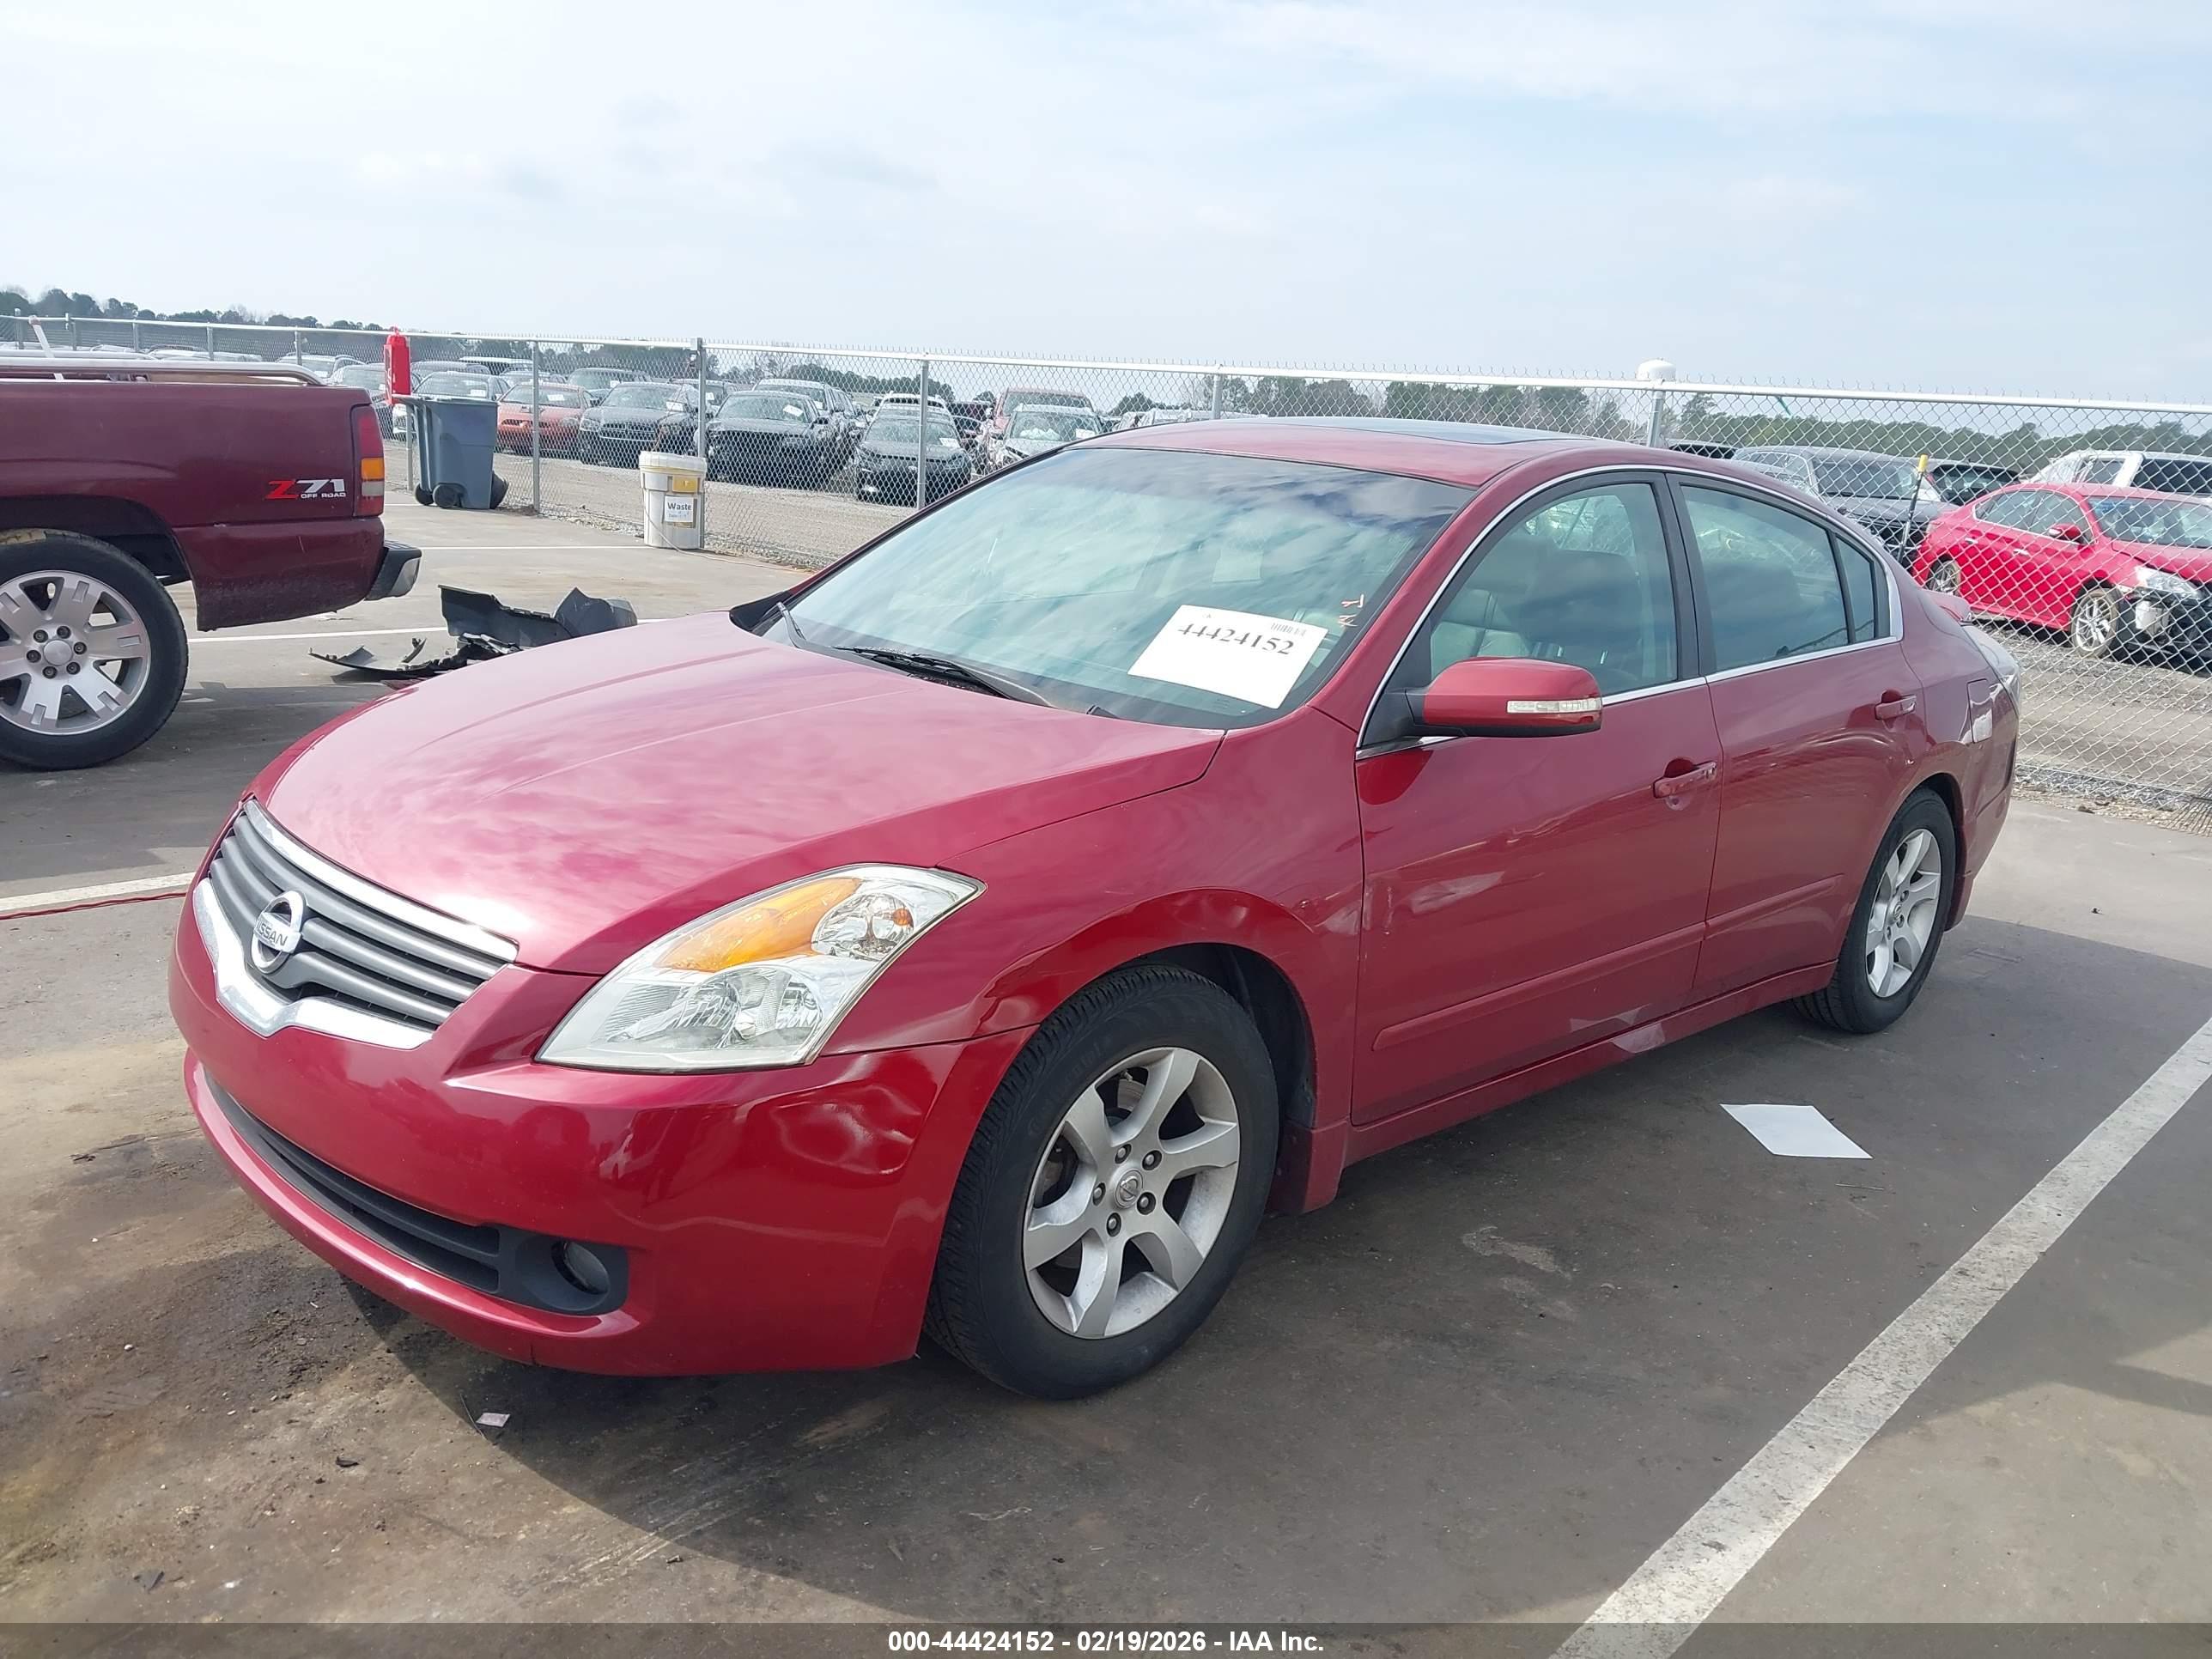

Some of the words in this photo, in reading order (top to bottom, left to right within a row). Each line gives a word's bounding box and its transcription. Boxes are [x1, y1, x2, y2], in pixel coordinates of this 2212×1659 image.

[265, 478, 345, 499] Z71
[667, 502, 692, 511] Waste
[1178, 623, 1294, 655] 44424152
